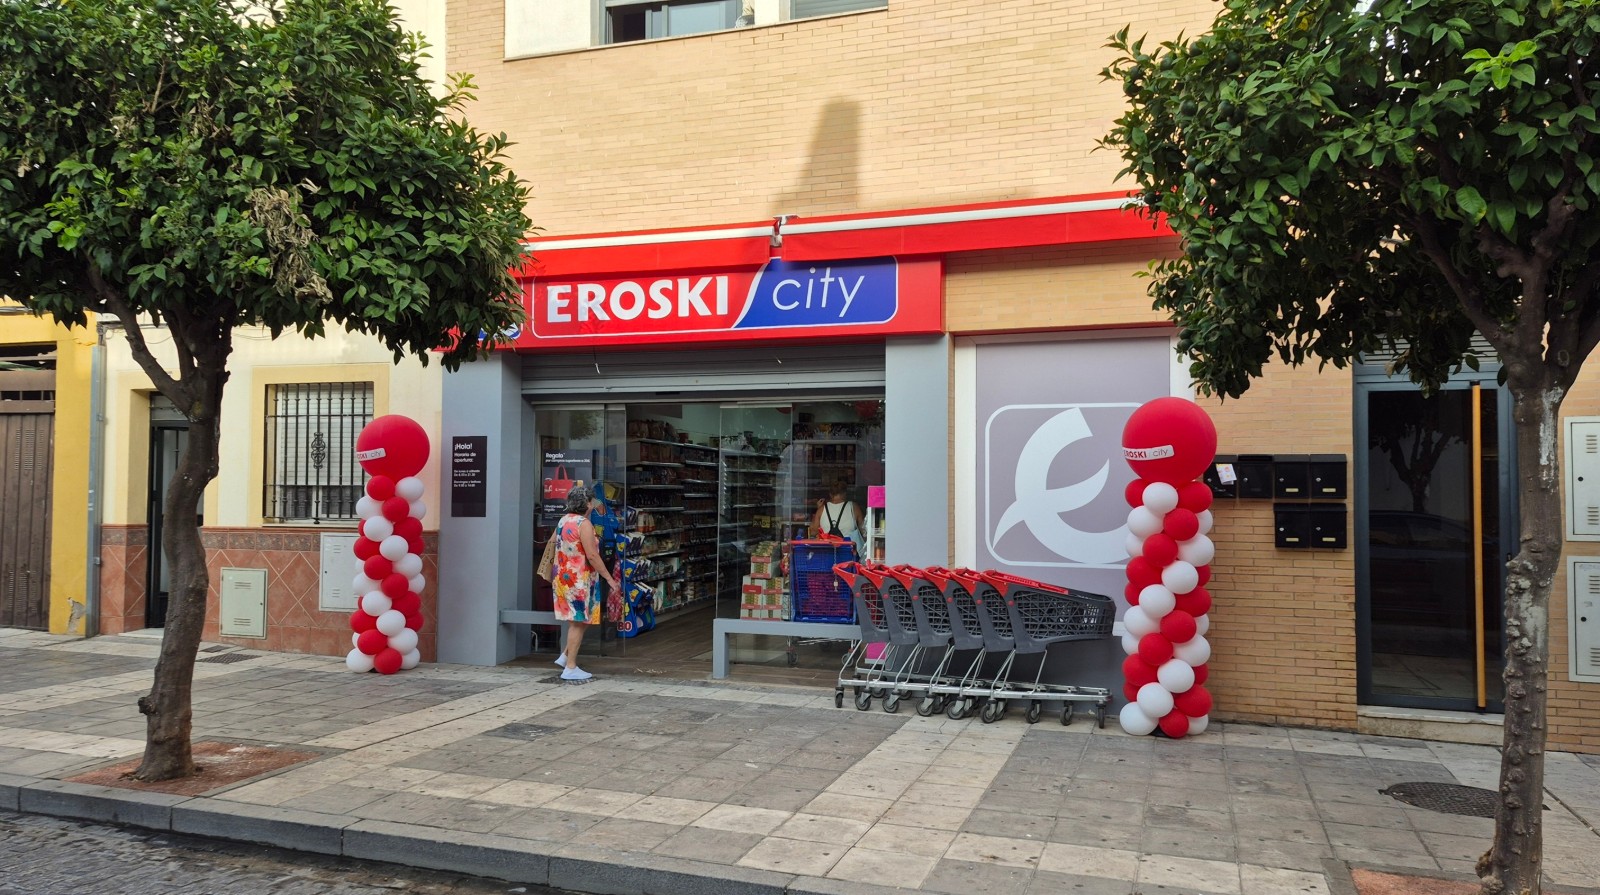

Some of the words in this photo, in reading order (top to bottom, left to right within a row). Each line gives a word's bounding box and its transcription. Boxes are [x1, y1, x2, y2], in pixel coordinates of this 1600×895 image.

[547, 275, 728, 323] EROSKI
[772, 267, 865, 318] city
[454, 443, 473, 451] ¡Hola!
